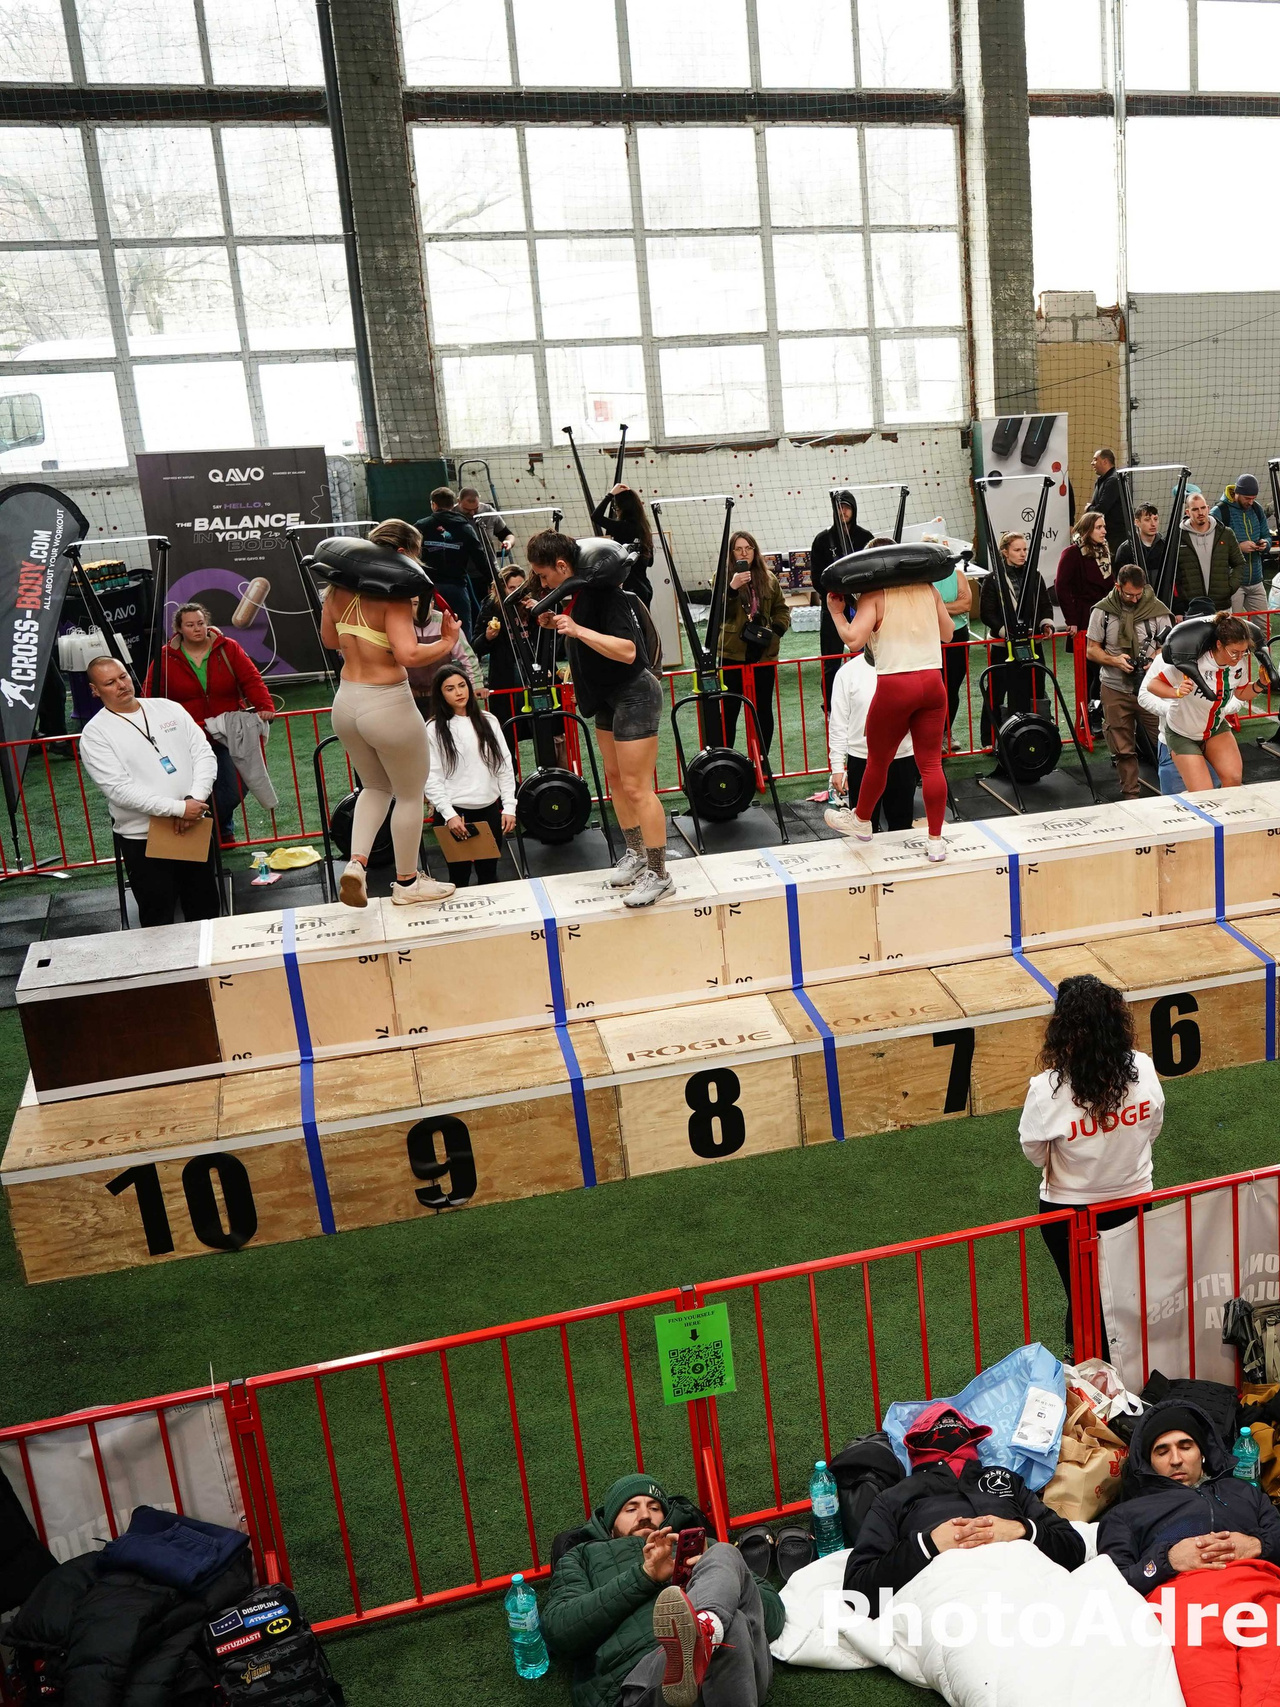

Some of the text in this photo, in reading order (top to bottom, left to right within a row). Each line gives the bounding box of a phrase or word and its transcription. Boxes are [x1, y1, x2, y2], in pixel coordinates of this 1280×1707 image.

[208, 467, 264, 483] QAVO
[52, 508, 64, 547] WORKOUT
[193, 530, 261, 544] IN YOUR
[228, 538, 289, 553] BODY
[49, 547, 58, 568] YOUR
[45, 567, 55, 597] ABOUT
[11, 529, 53, 681] CROSS-BODY.COM
[159, 719, 178, 729] JUDGE
[1163, 808, 1257, 825] METL ART
[1027, 825, 1127, 844] METAL ART
[953, 845, 988, 853] ART
[733, 863, 843, 883] METL ART
[407, 906, 530, 929] METAL ART
[694, 906, 712, 918] 50
[231, 927, 361, 951] METL ART
[1149, 992, 1201, 1077] 6
[626, 1030, 774, 1062] ROGUE
[932, 1027, 976, 1114] 7
[684, 1067, 746, 1159] 8
[1067, 1100, 1151, 1142] JUDGE
[406, 1115, 478, 1209] 9
[105, 1152, 259, 1257] 10
[668, 1310, 715, 1324] FIND YOURSELF
[684, 1320, 701, 1328] HERE
[984, 1470, 1011, 1479] PARIS
[241, 1600, 280, 1615] DISCIPLINA
[248, 1609, 284, 1624] ATHLETE
